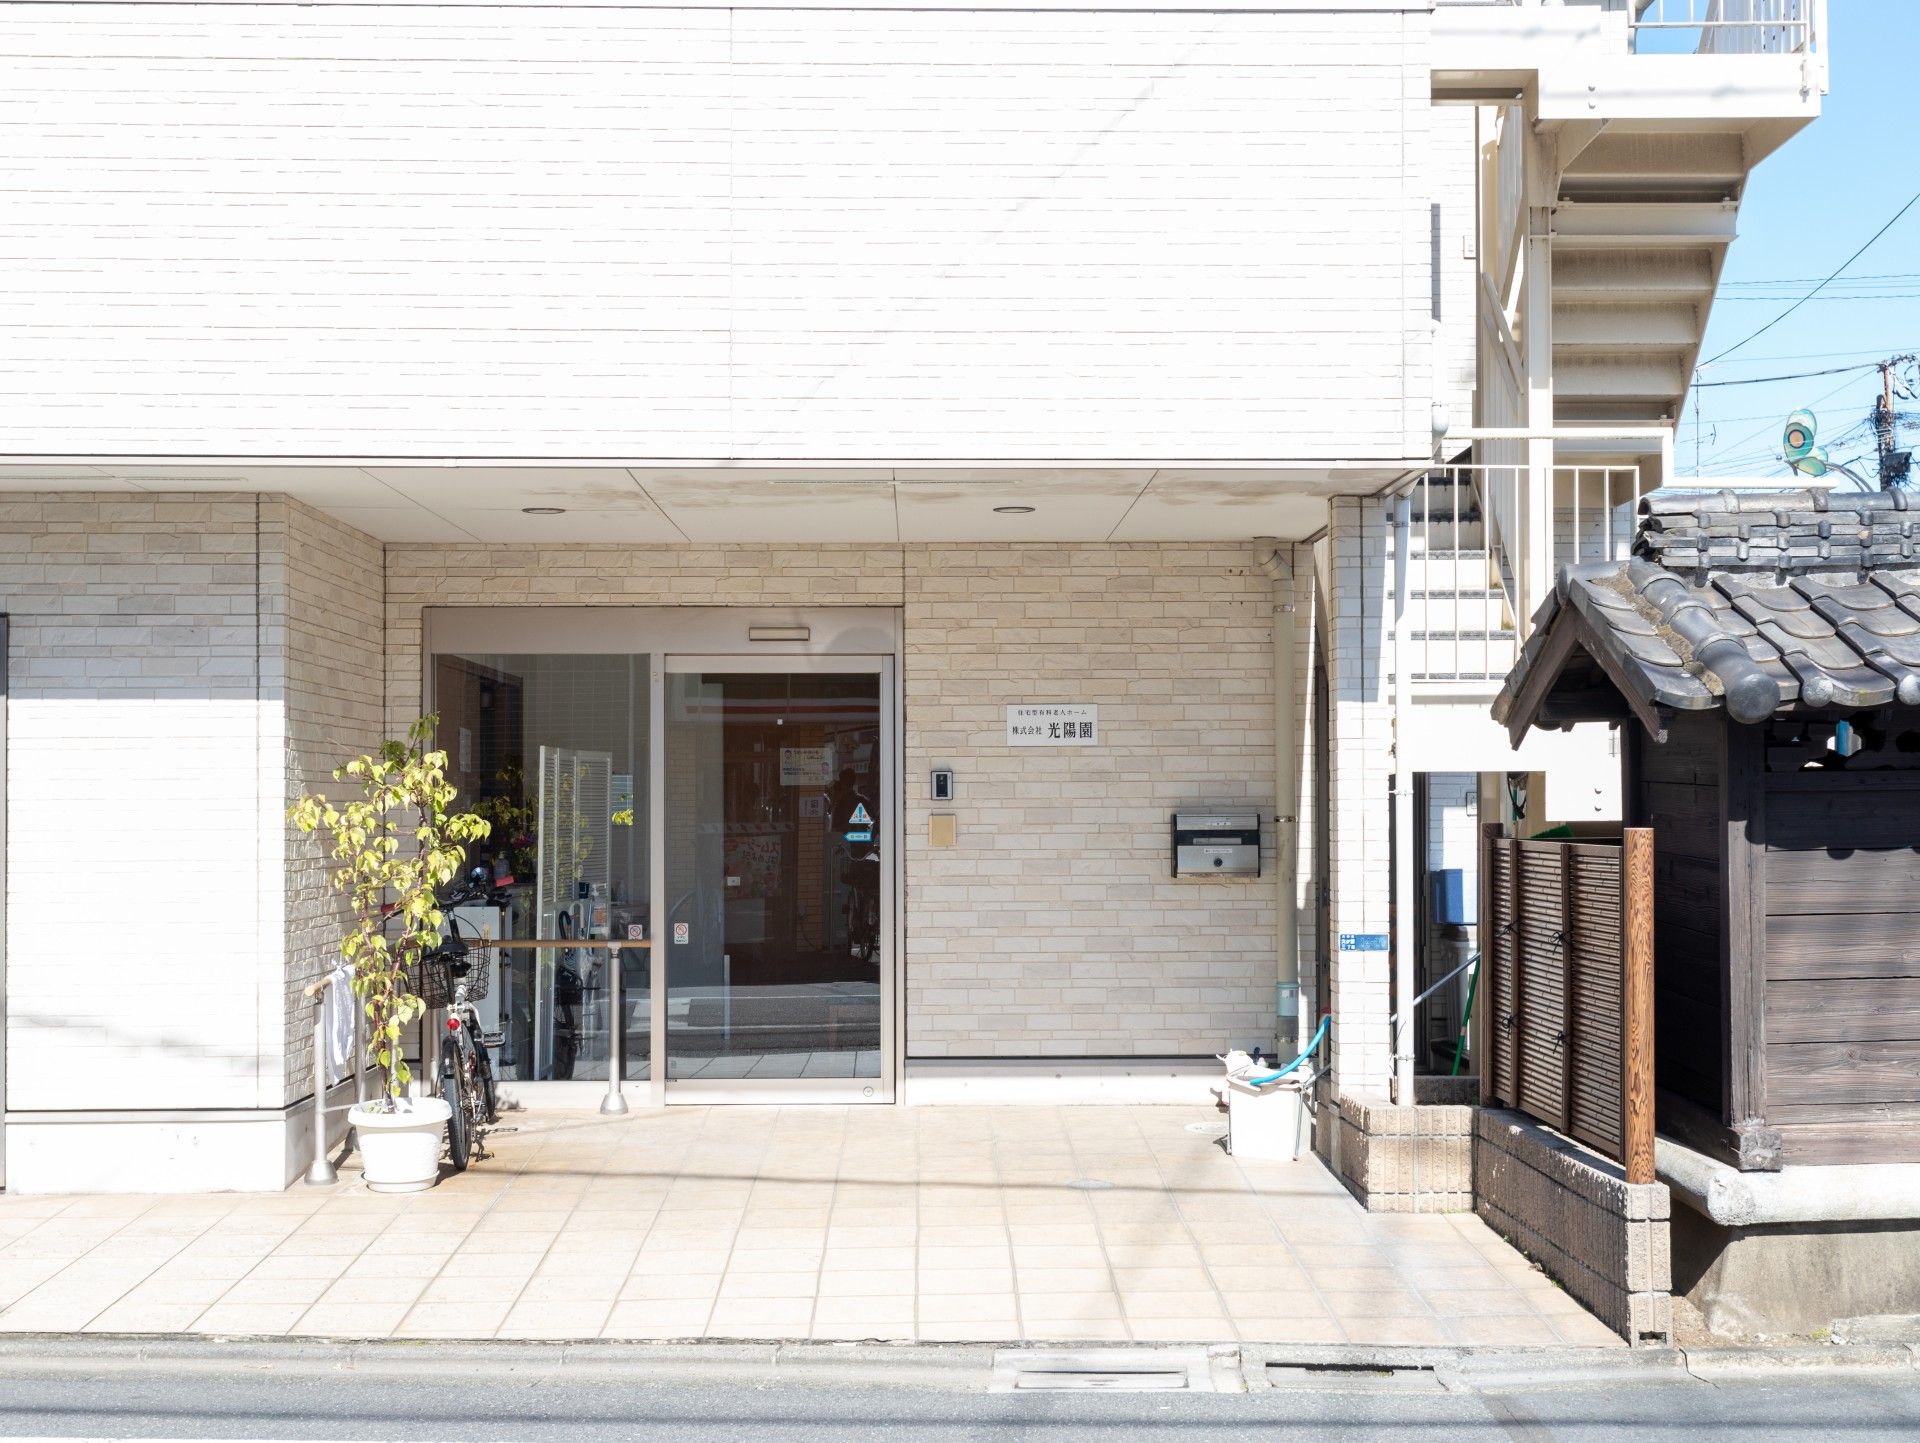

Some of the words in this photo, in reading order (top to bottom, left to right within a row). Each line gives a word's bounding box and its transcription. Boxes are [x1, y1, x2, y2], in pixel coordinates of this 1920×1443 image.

[1012, 725, 1042, 735] 株式会社
[1047, 721, 1093, 738] 光陽園
